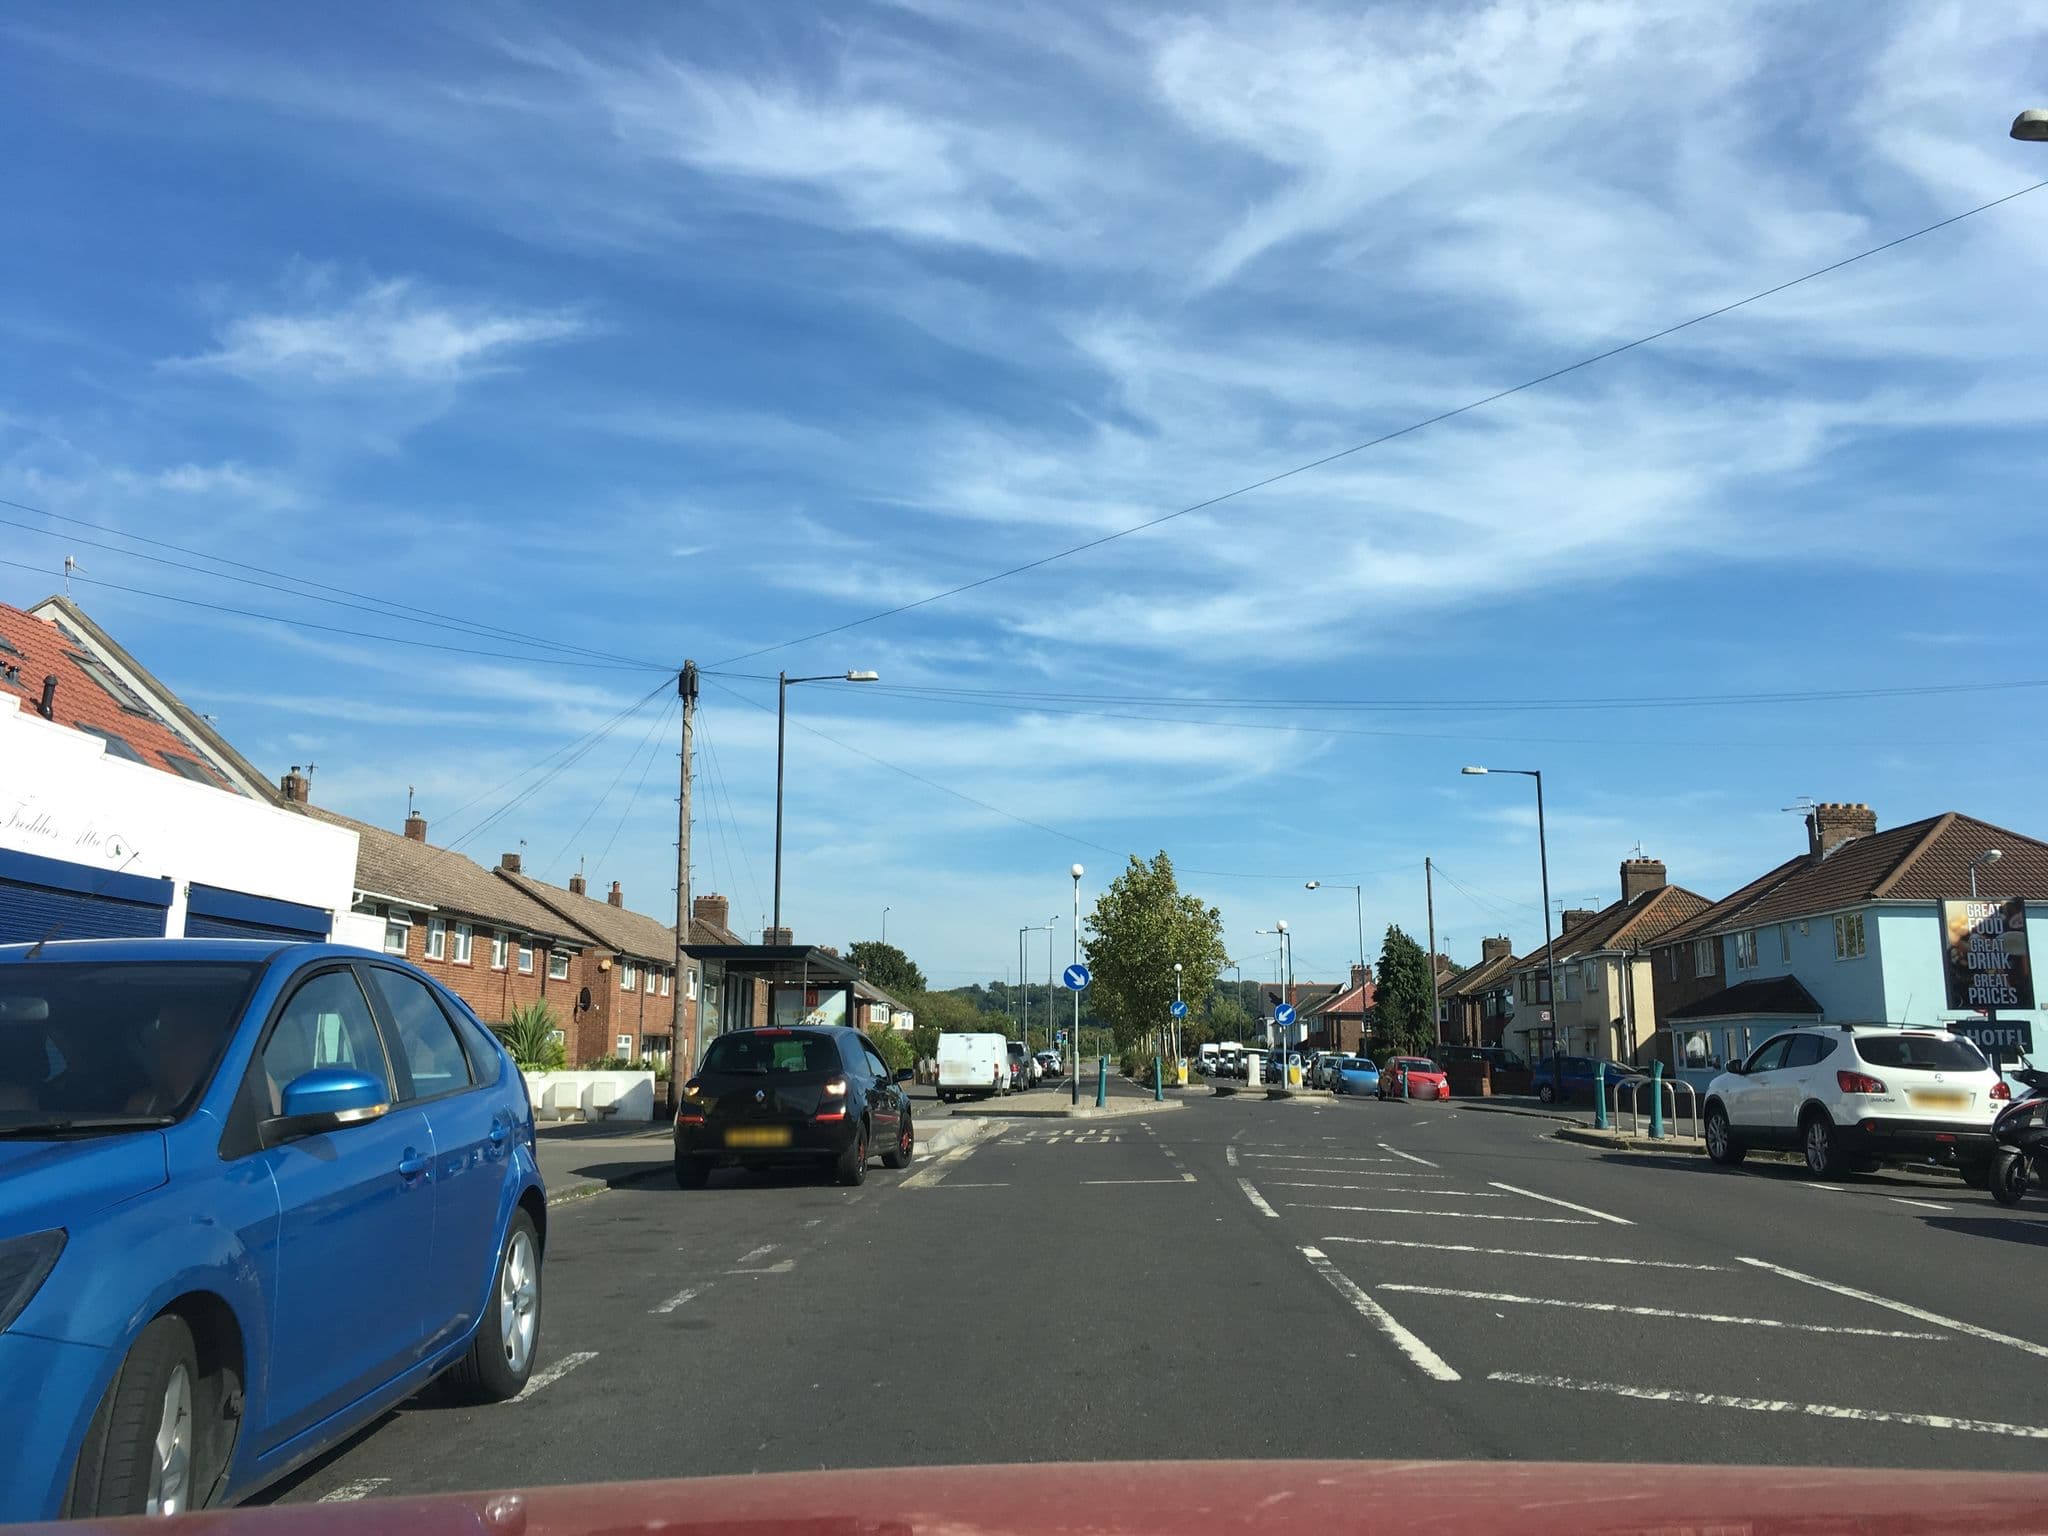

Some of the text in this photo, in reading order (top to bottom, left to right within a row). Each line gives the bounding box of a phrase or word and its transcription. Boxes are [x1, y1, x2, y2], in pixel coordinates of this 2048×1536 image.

[1967, 903, 2000, 917] GREAT
[1967, 918, 2003, 934] FOOD
[1971, 938, 2004, 952] GREAT
[1967, 953, 2011, 969] DRINK
[1974, 973, 2008, 987] GREAT
[1968, 988, 2017, 1004] PRICES
